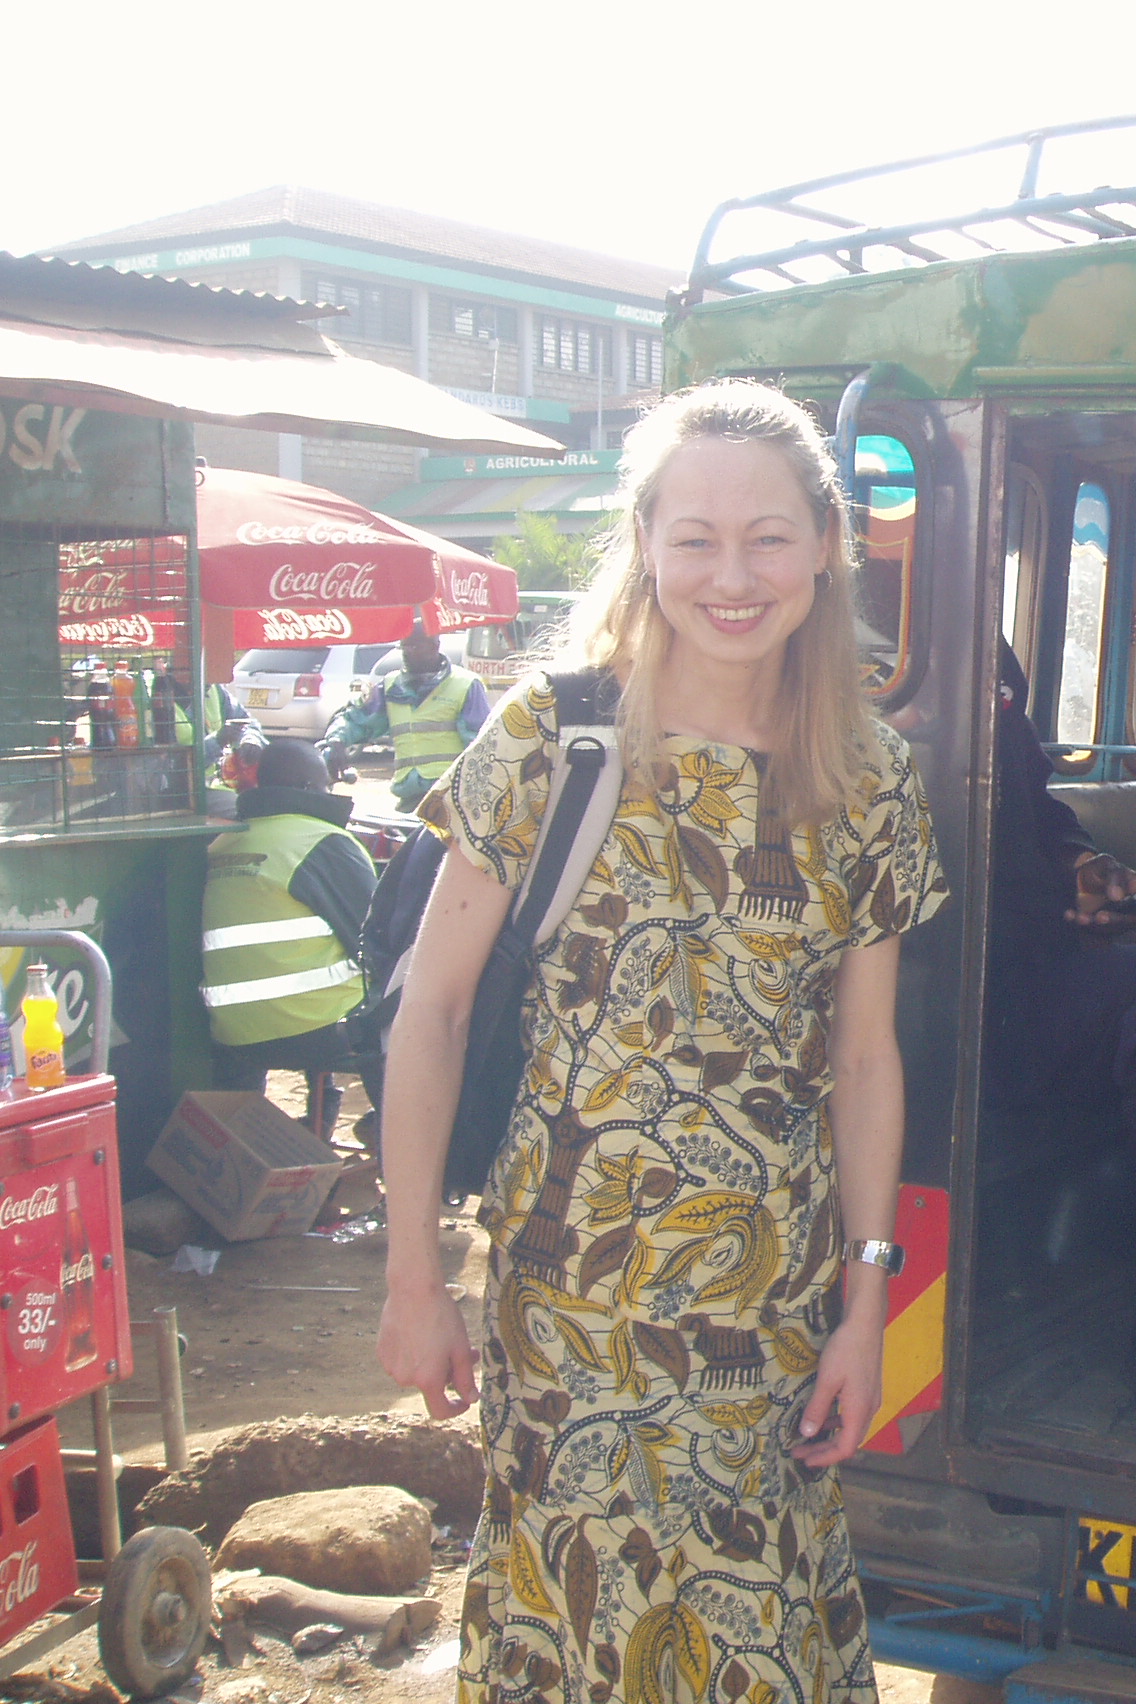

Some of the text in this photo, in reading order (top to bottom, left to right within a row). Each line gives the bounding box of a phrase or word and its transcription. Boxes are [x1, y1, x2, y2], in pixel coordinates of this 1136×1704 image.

[176, 242, 250, 266] CORPORATION
[0, 403, 87, 473] SK
[269, 561, 373, 601] Coca-Cola
[0, 1183, 59, 1229] Coca-Cola
[26, 1292, 55, 1306] 500ml
[18, 1308, 56, 1334] 33/-
[24, 1335, 47, 1352] only
